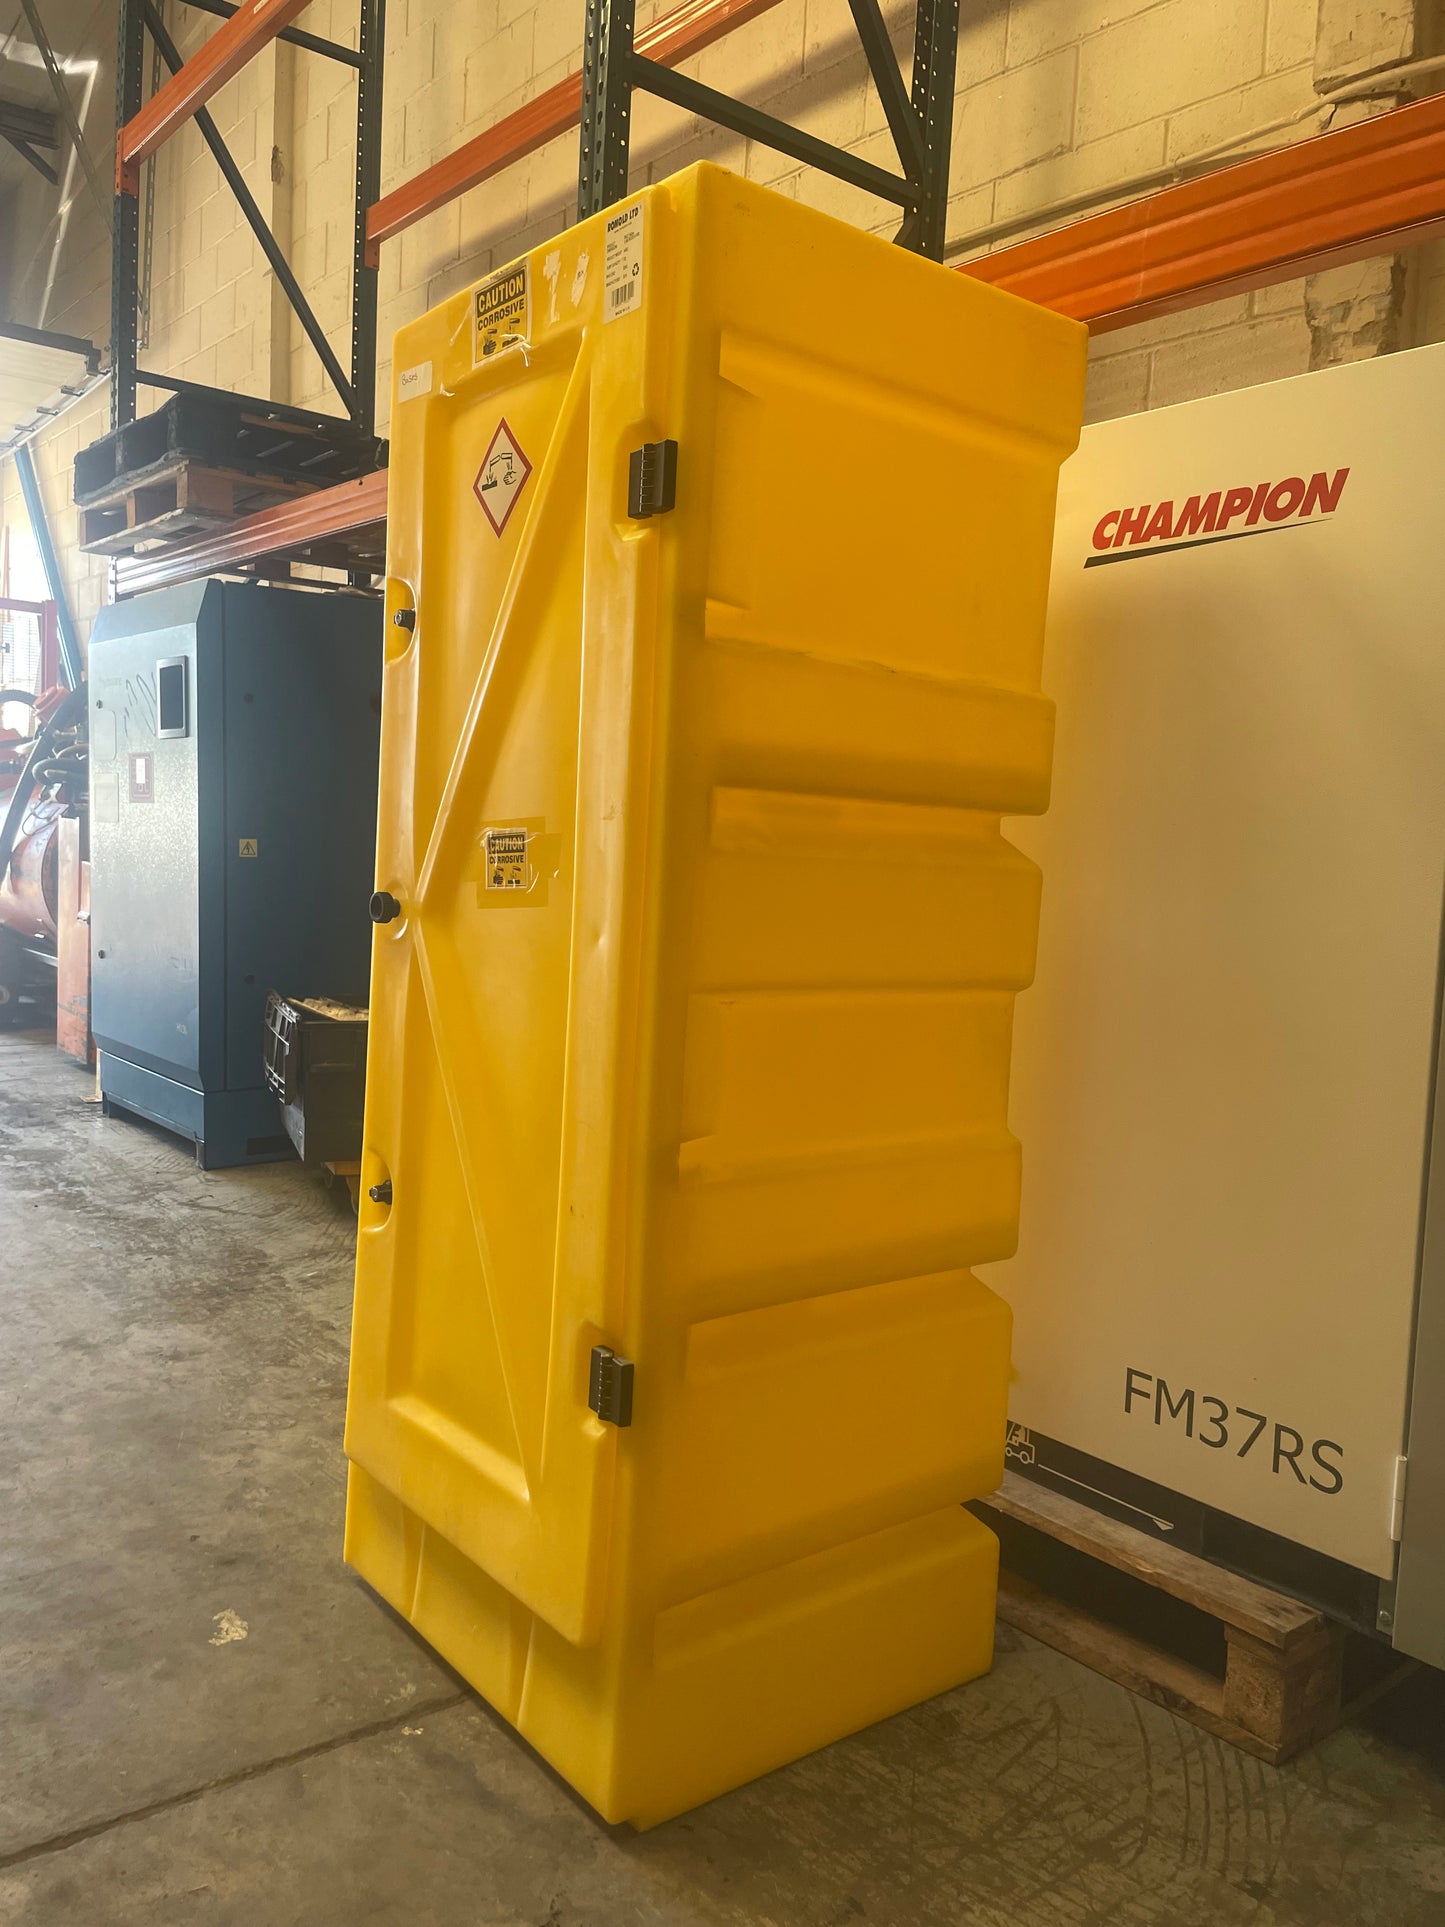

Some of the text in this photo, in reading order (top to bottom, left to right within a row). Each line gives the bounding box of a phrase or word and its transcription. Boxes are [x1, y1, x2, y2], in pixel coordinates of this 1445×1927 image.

[607, 213, 628, 232] ROMOLD
[629, 207, 639, 220] LTD
[478, 273, 524, 313] CAUTION
[477, 298, 525, 331] CORROSIVE
[1092, 467, 1350, 550] CHAMPION
[489, 836, 524, 852] CAUTION
[489, 855, 524, 864] CORROSIVE
[1123, 1366, 1344, 1495] FM37RS
